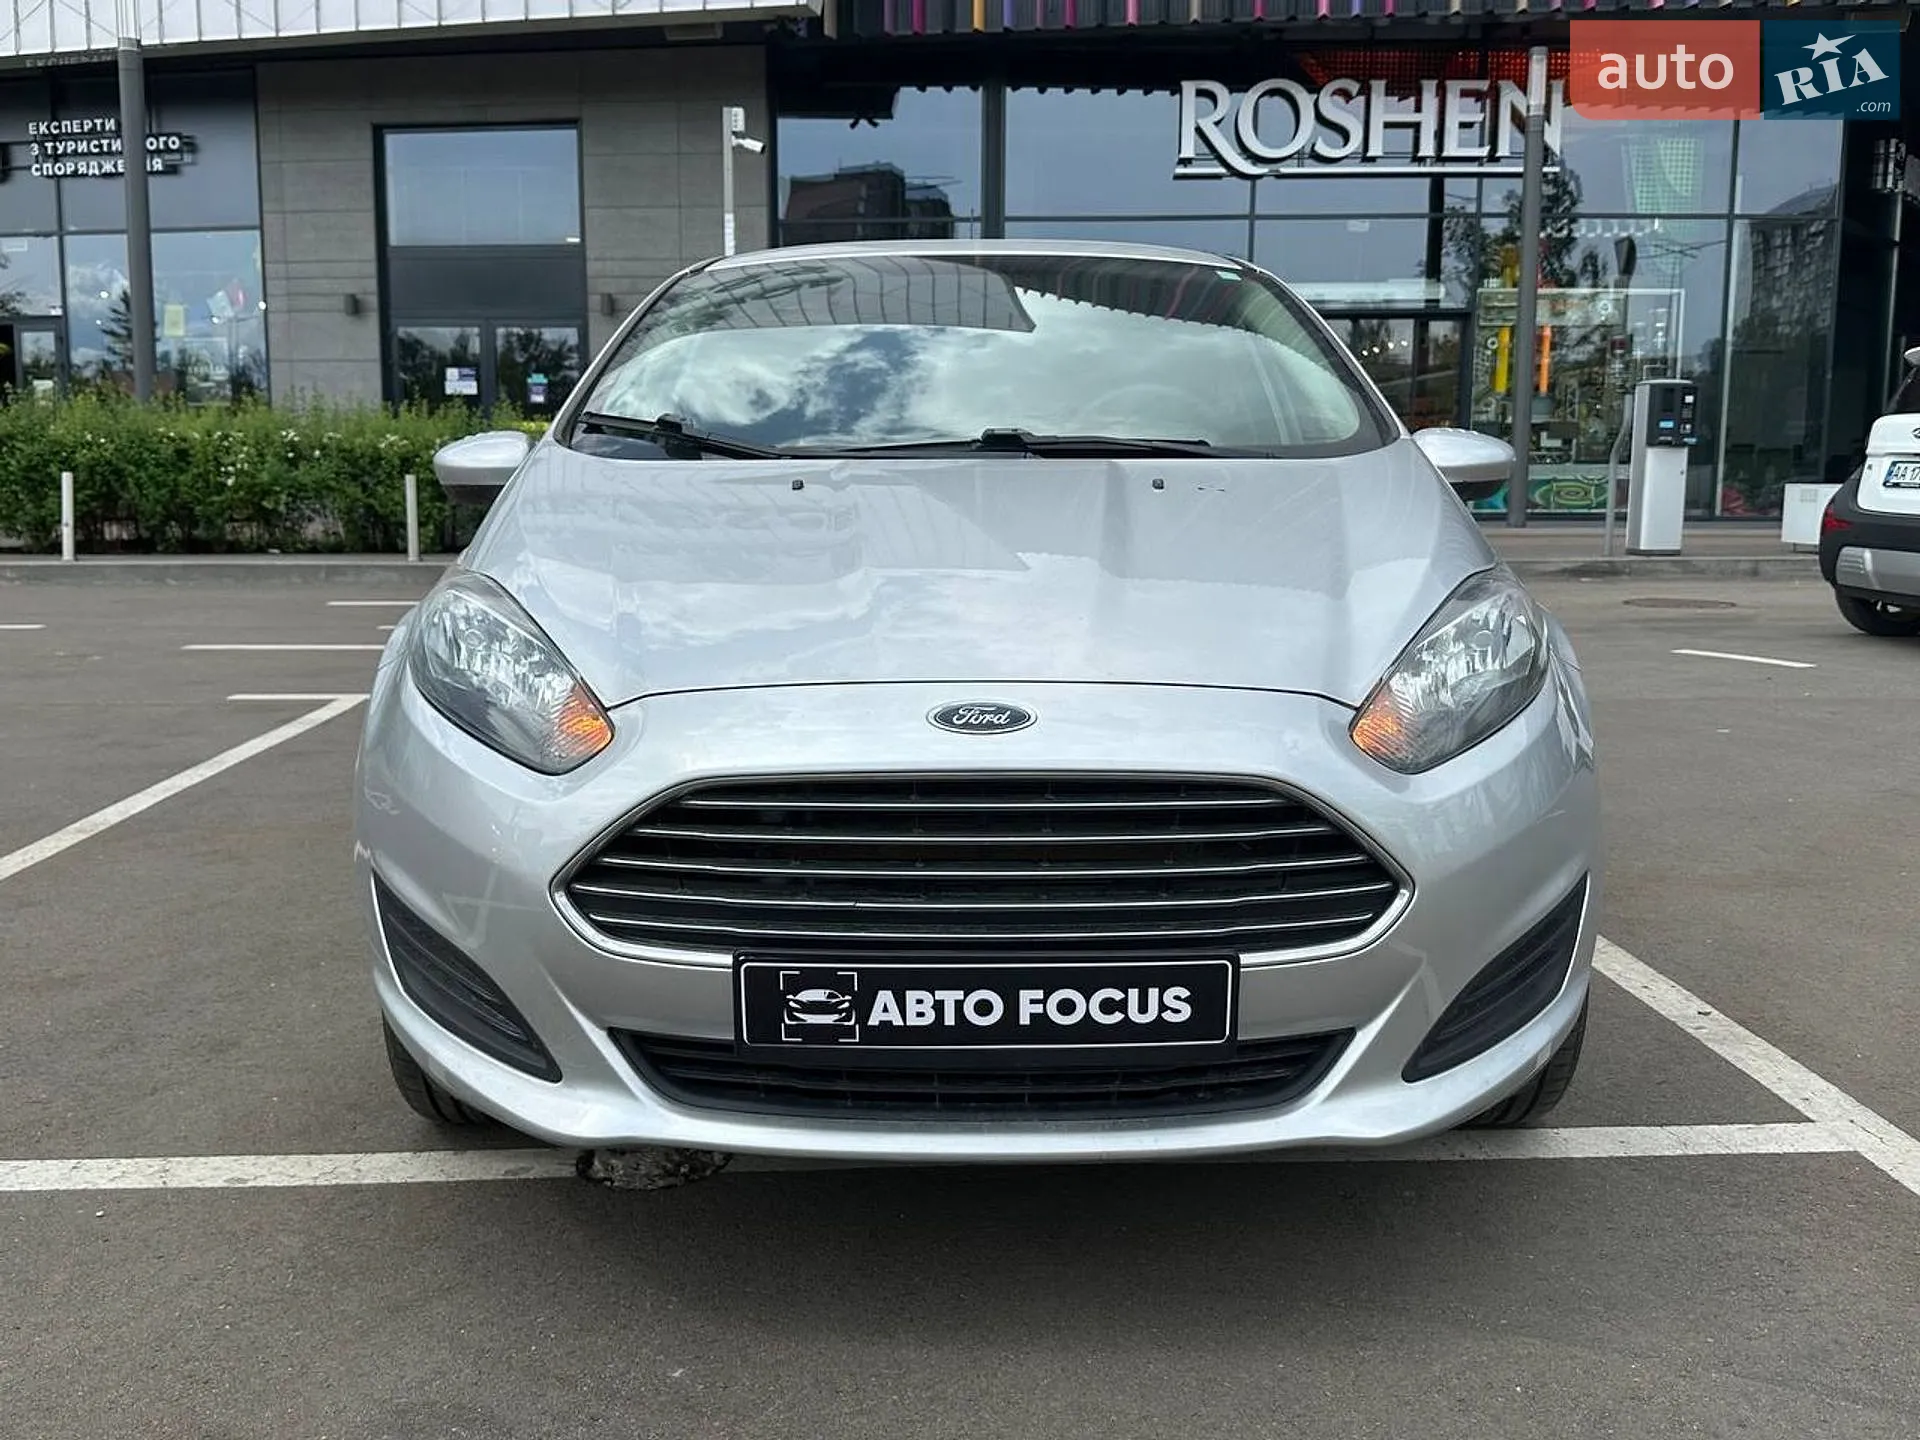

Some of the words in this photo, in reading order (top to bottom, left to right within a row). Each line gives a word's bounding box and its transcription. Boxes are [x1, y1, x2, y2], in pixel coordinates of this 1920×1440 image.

[28, 118, 116, 135] ЕКСПЕРТИ
[1178, 77, 1562, 178] ROSHEN
[44, 136, 180, 155] ТУРИСТИОГО
[31, 158, 164, 177] СПОРЯДЖЕЯ
[952, 706, 1011, 725] Ford
[1018, 987, 1192, 1026] FOCUS
